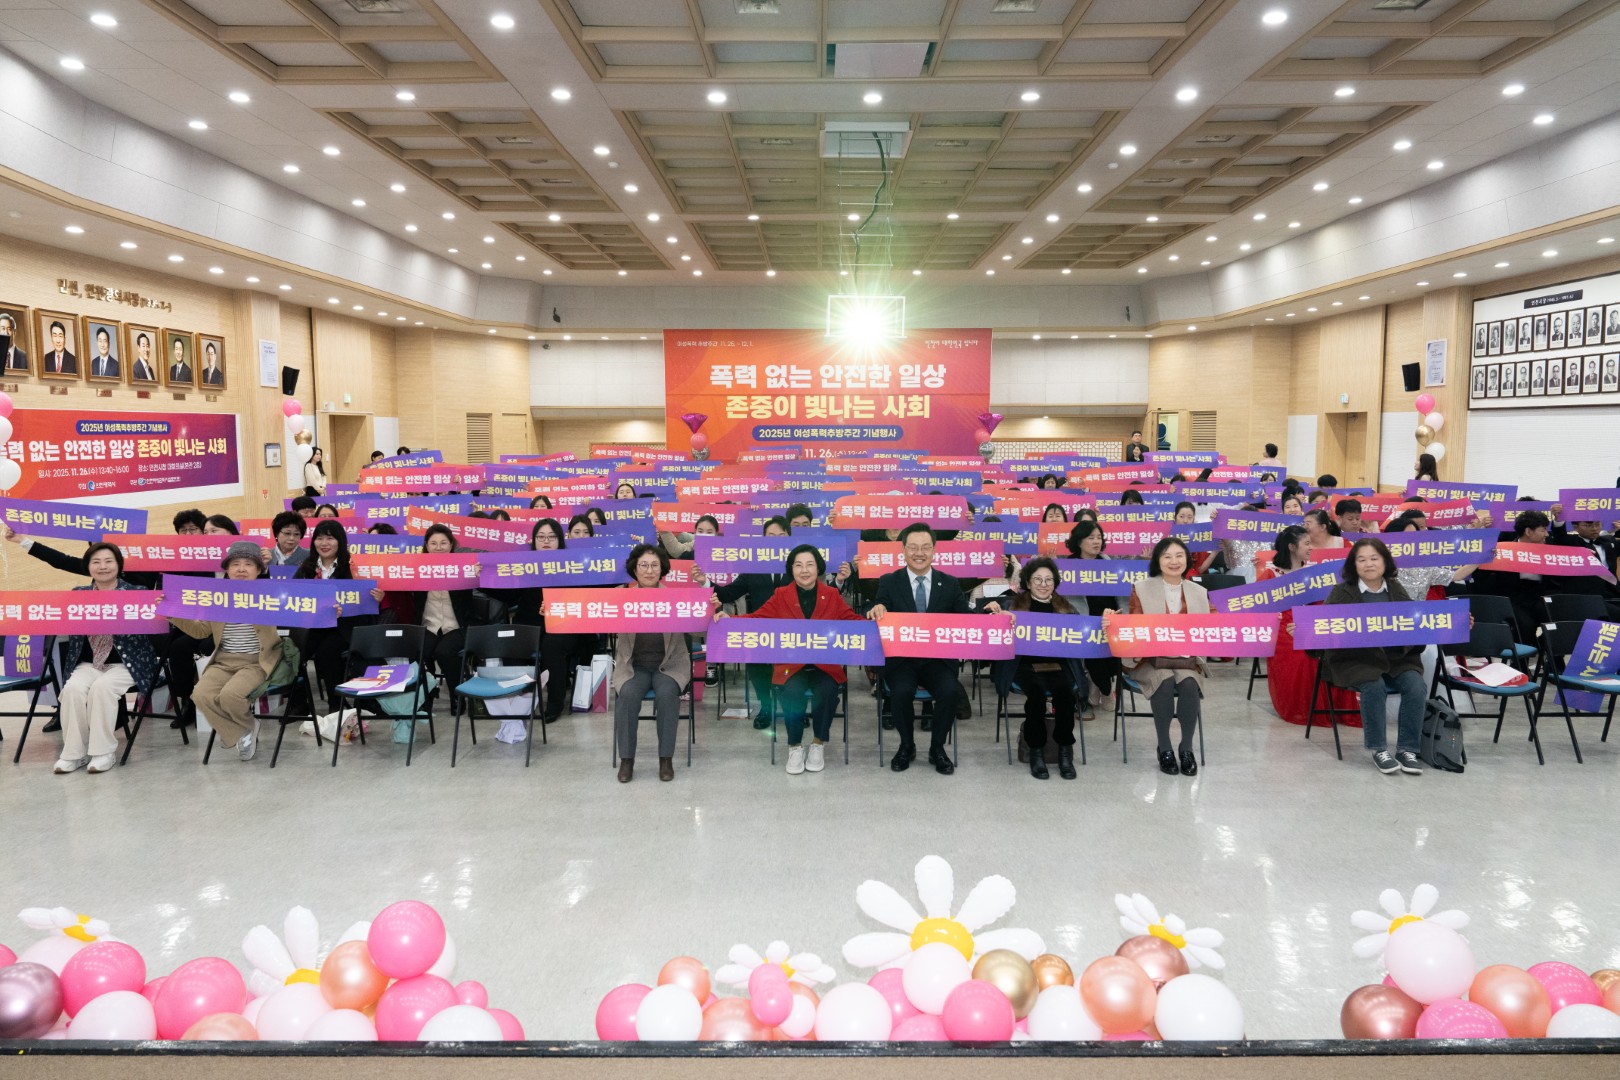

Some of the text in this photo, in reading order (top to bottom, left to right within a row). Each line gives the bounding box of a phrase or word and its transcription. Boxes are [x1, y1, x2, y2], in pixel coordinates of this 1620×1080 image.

[710, 364, 946, 388] 폭력 없는 안전한 일상
[726, 395, 930, 418] 존중이 빛나는 사회
[80, 423, 104, 432] 2025년
[759, 428, 897, 438] 2025년 여성폭력추방주간 기념행사
[28, 440, 60, 462] 없는
[64, 440, 106, 460] 안전한
[109, 440, 134, 460] 일상
[138, 438, 172, 458] 존중이
[174, 438, 206, 456] 빛나는
[208, 438, 227, 454] 사회
[804, 449, 817, 458] 11.
[394, 456, 435, 468] 빛나는 사회
[882, 464, 898, 472] 일상
[52, 468, 70, 478] 2025.
[365, 474, 451, 484] 폭력 없는 안전한 일상
[464, 475, 479, 483] 일상
[494, 474, 516, 482] 존중이
[1086, 474, 1100, 482] 폭력
[1101, 473, 1116, 481] 없는
[1140, 470, 1154, 478] 일상
[644, 478, 668, 486] 빛나는
[928, 478, 972, 486] 빛나는 사회
[682, 484, 748, 495] 폭력 없는 안전한
[1182, 488, 1246, 496] 존중이 빛나는 사회
[1417, 488, 1447, 499] 존중이
[1484, 492, 1506, 502] 사회
[368, 503, 460, 518] 존중이 사회
[1574, 498, 1612, 510] 존중이
[616, 509, 646, 520] 빛나는
[657, 512, 700, 522] 폭력 없는
[842, 505, 962, 518] 폭력 없는 안전한 일상
[1022, 506, 1040, 517] 없는
[1126, 512, 1175, 522] 빛나는 사회
[1434, 507, 1464, 520] 안전한
[6, 508, 128, 534] 존중이 빛나는 사회
[1227, 518, 1258, 530] 존중이
[464, 525, 528, 545] 안전한 일상
[989, 532, 1024, 544] 빛나는
[1139, 532, 1163, 544] 일상
[1192, 531, 1212, 542] 사회
[146, 546, 222, 560] 없는 안전한
[1418, 540, 1482, 556] 빛나는 사회
[712, 548, 752, 562] 존중이
[867, 552, 996, 566] 폭력 일상
[1516, 551, 1584, 566] 없는 안전한
[357, 564, 460, 578] 폭력 없는 안전한
[496, 558, 616, 577] 존중이 빛나는 사회
[665, 570, 688, 582] 없는
[1080, 570, 1118, 584] 빛나는
[1228, 572, 1337, 612] 존중이 빛나는 사회
[181, 588, 317, 614] 존중이 빛나는 사회
[28, 604, 157, 620] 없는 안전한 일상
[550, 602, 708, 618] 폭력 없는 안전한 일상
[1314, 613, 1452, 635] 존중이 빛나는 사회
[726, 632, 866, 650] 존중이 빛나는 사회
[898, 626, 930, 643] 없는
[935, 627, 982, 644] 안전한
[987, 628, 1014, 645] 일상
[1036, 626, 1082, 644] 빛나는
[1118, 626, 1272, 643] 폭력 없는 안전한 일상
[1588, 622, 1620, 664] 빛나는
